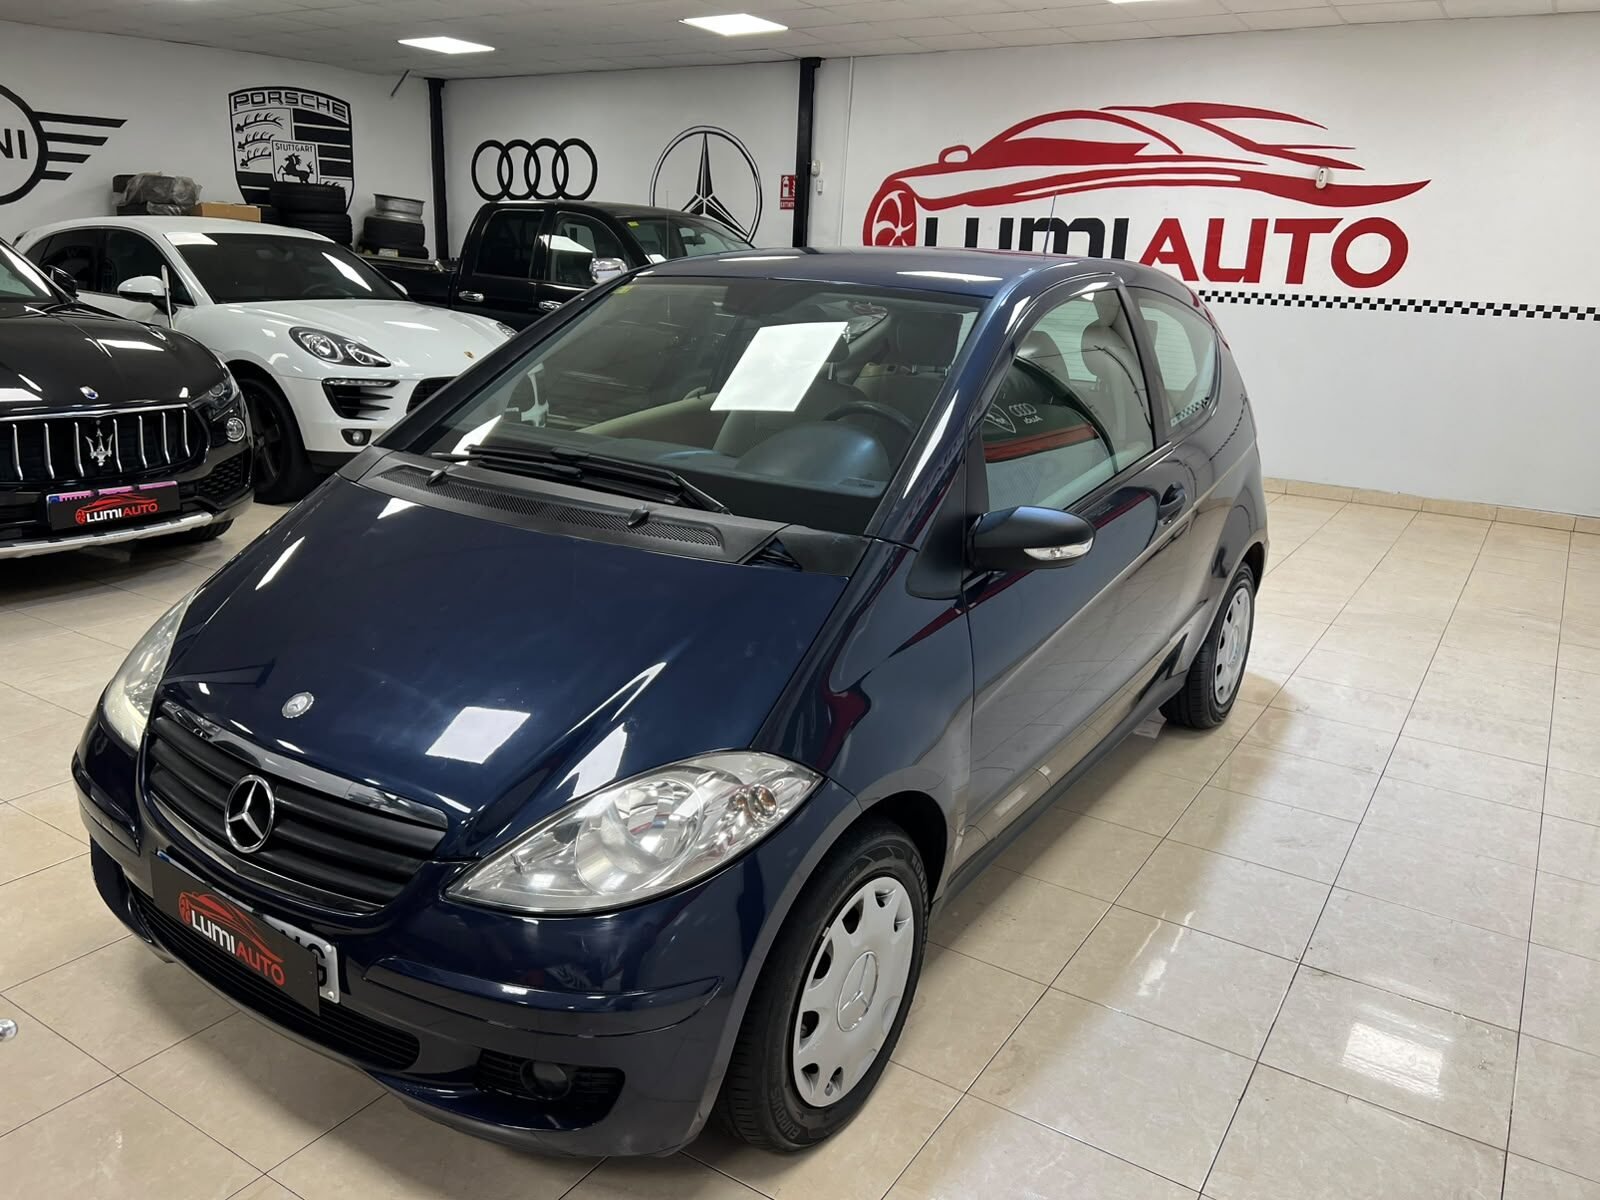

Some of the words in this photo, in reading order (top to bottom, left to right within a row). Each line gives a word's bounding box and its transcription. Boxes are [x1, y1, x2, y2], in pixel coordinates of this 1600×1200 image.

[233, 91, 347, 120] PORSCHE
[275, 143, 314, 153] STUTTGART
[86, 502, 158, 523] LUMIAUTO
[191, 909, 286, 986] LUMIAUTO
